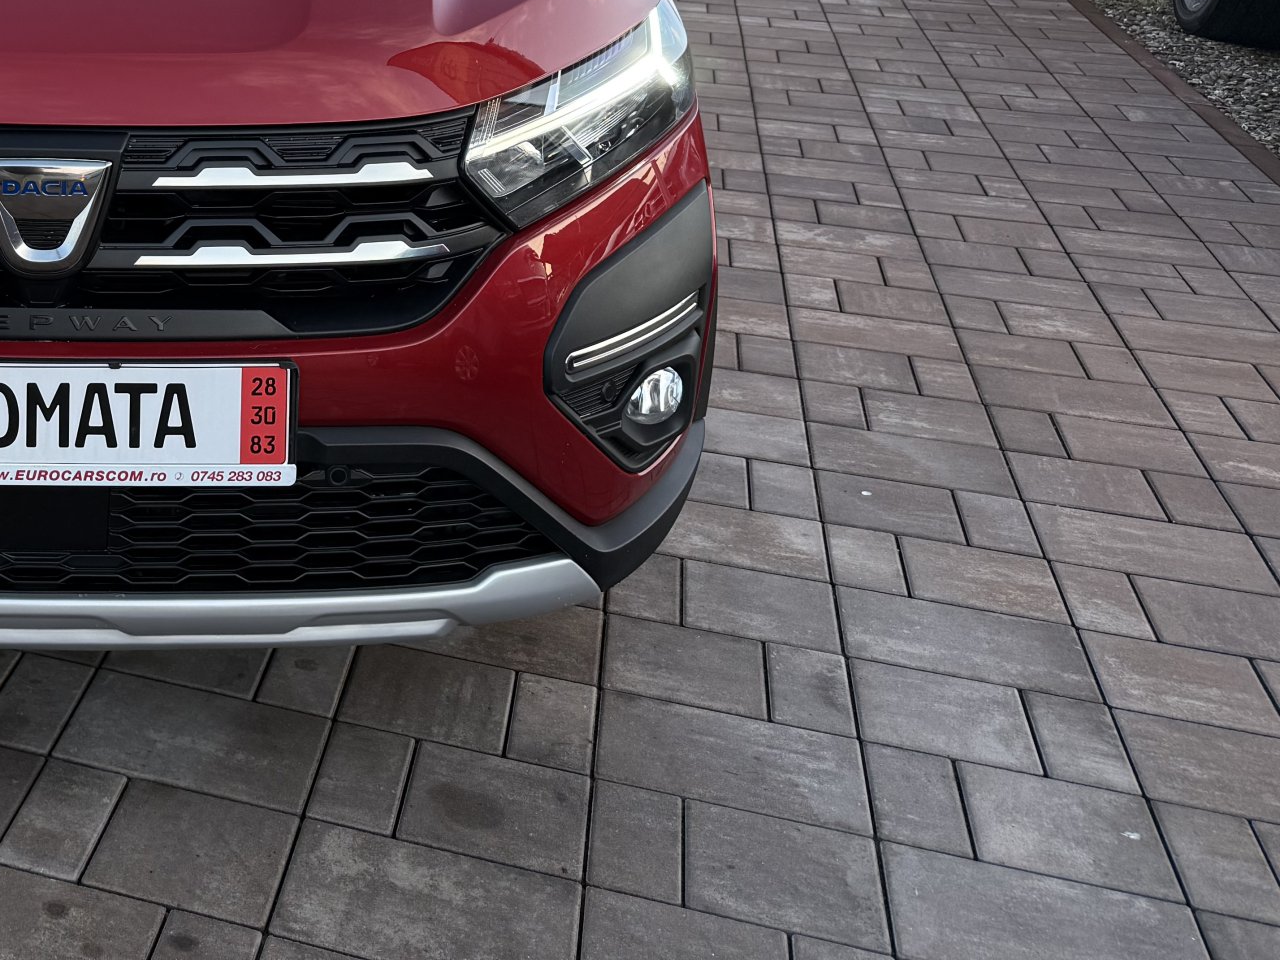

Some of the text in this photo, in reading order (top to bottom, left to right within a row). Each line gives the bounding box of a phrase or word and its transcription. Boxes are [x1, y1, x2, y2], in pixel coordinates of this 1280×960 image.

[0, 179, 89, 197] DACIA
[250, 377, 277, 396] 28
[250, 405, 276, 425] 30
[249, 435, 276, 454] 83
[190, 470, 224, 482] 0745
[227, 470, 254, 482] 283
[256, 471, 282, 482] 083
